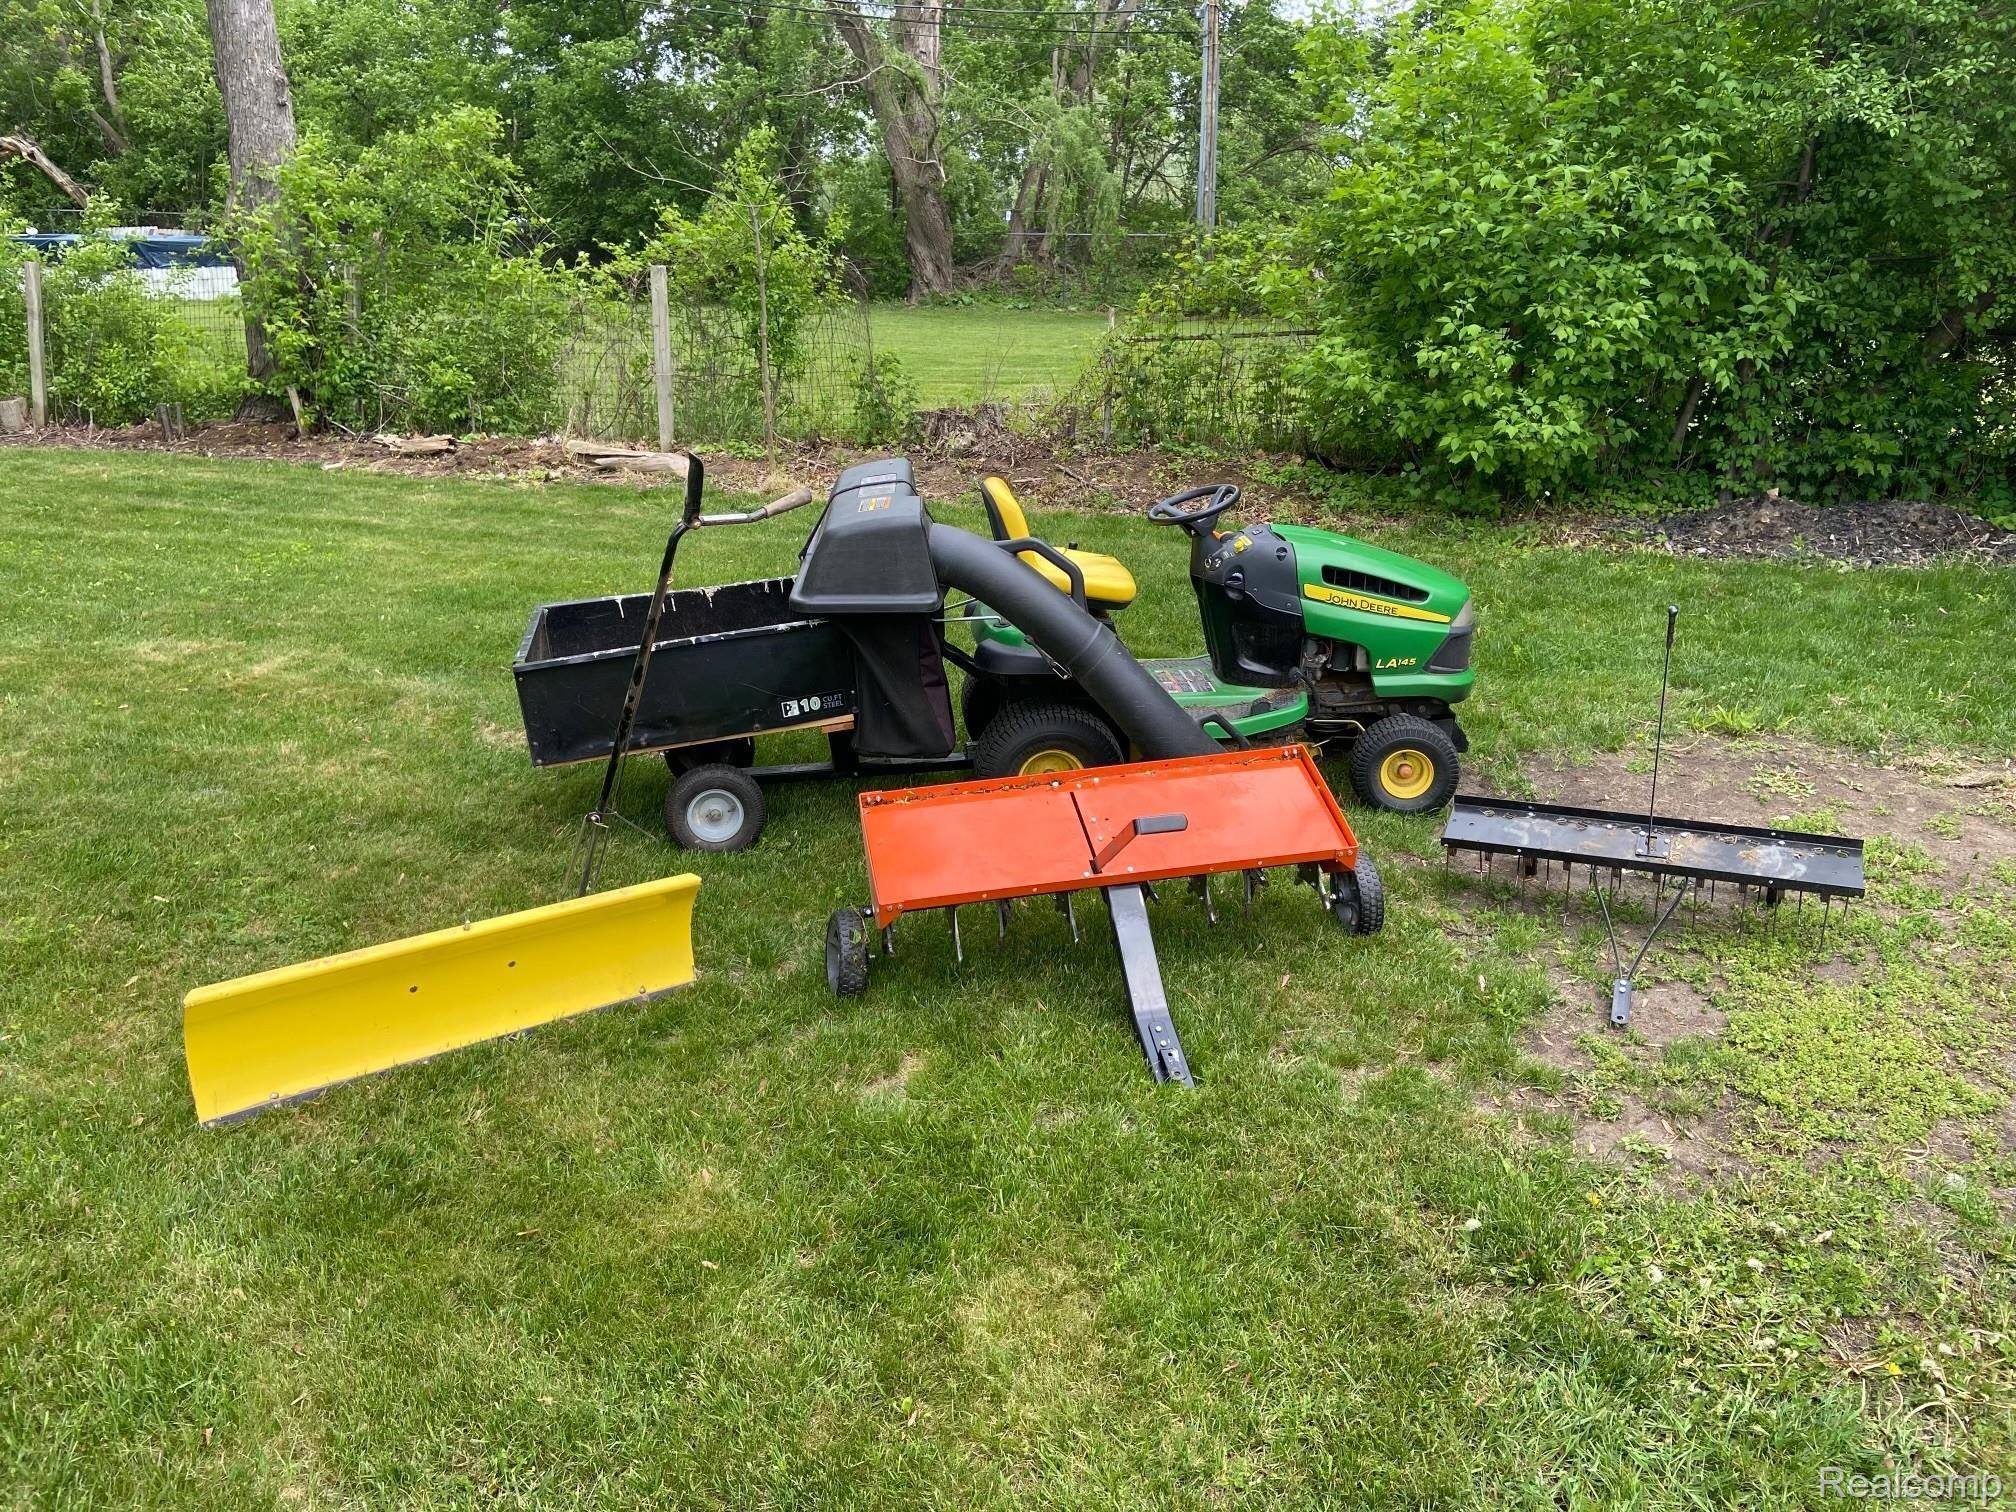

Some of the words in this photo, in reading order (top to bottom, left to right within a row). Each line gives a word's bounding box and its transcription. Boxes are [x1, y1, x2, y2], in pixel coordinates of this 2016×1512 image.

[1326, 594, 1358, 607] JOHN
[1361, 600, 1399, 615] DEERE
[800, 696, 821, 712] 10
[823, 701, 844, 709] STEEL
